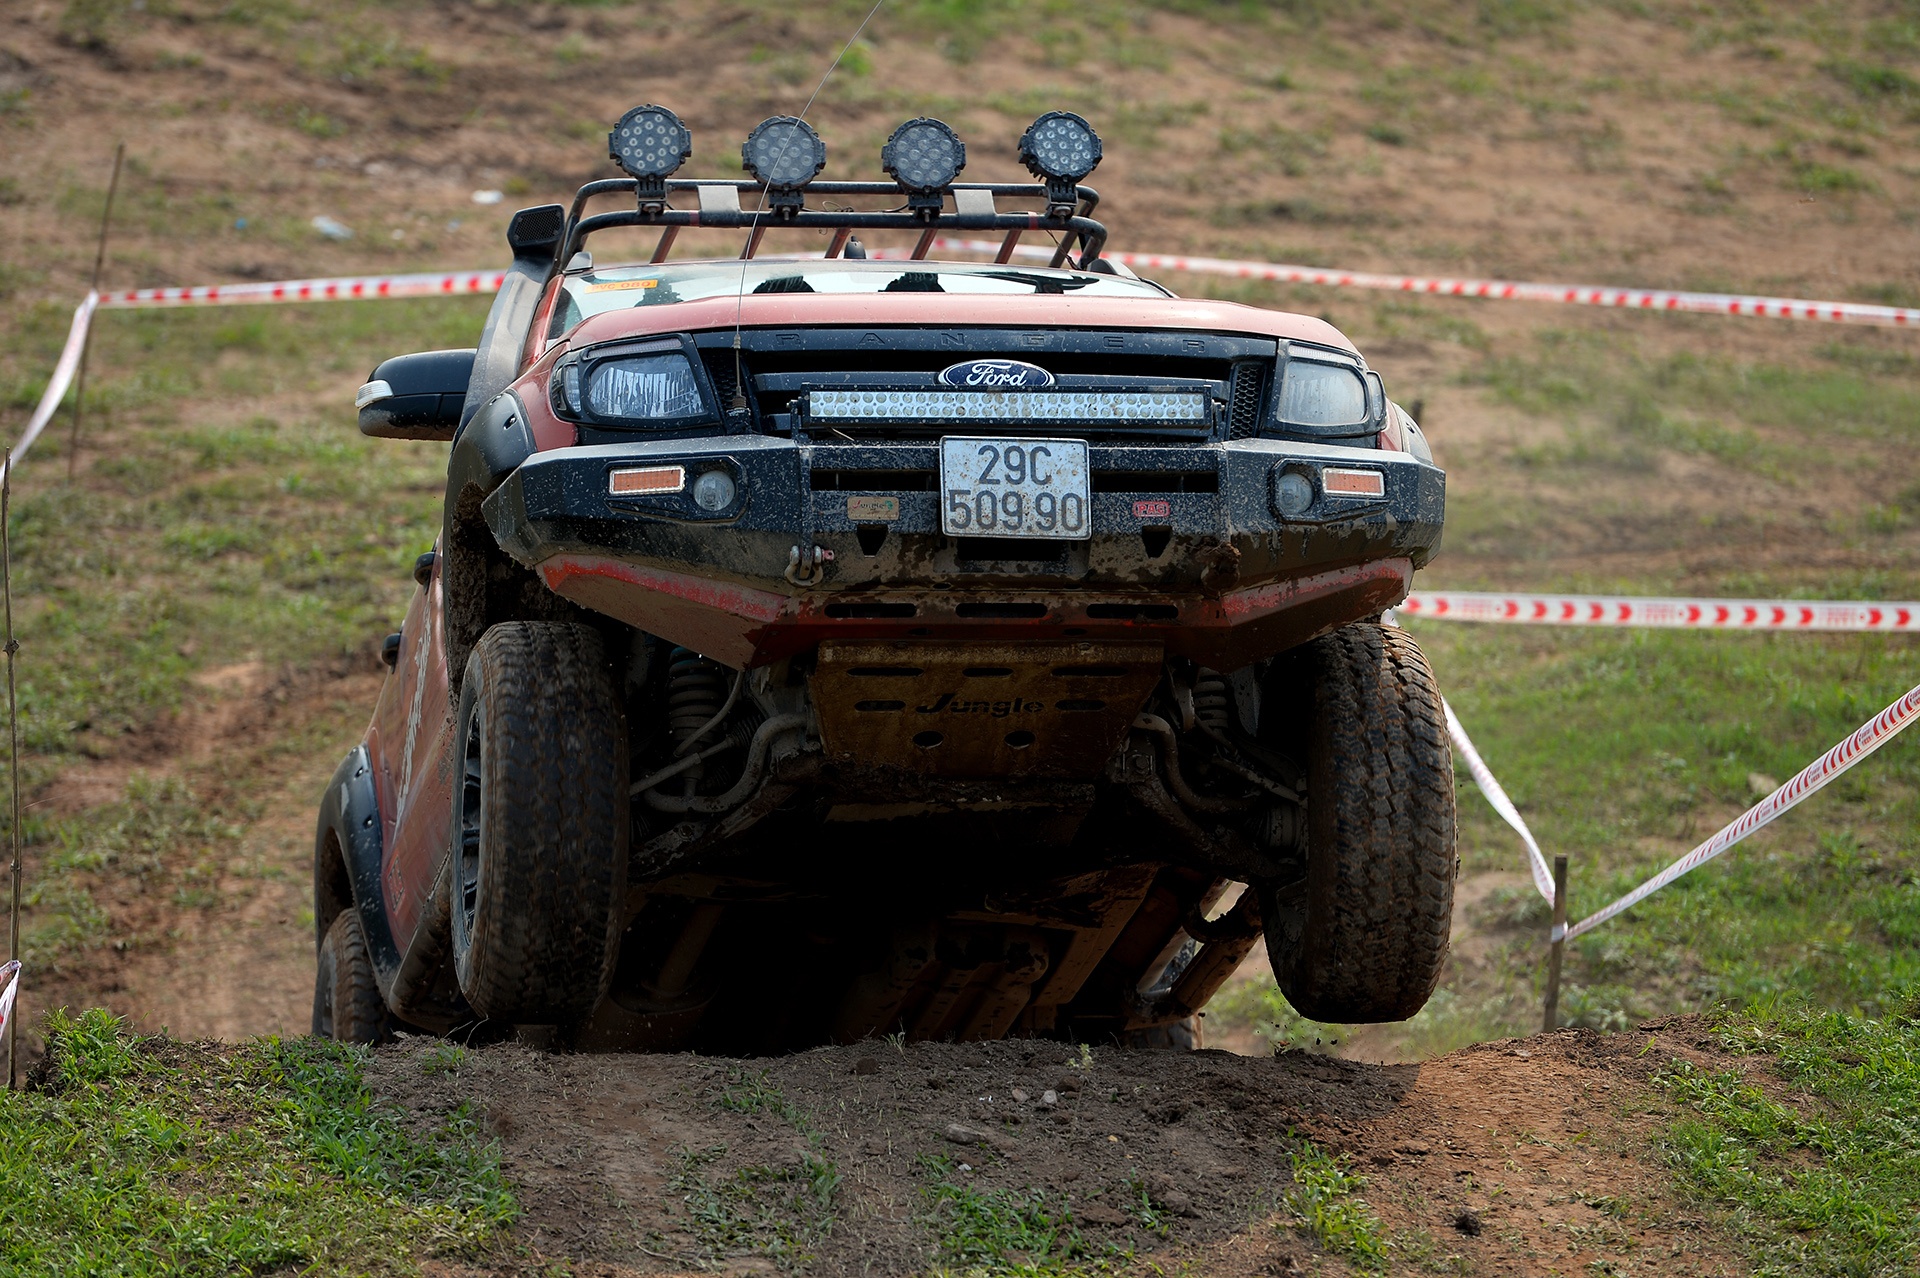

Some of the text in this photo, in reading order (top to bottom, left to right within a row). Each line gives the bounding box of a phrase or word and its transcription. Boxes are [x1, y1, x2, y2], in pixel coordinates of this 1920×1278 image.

[776, 333, 1206, 353] RANGER
[966, 363, 1028, 386] Ford
[978, 444, 1052, 485] 29C
[948, 489, 1083, 531] 509.90
[916, 693, 1045, 718] Jungle
